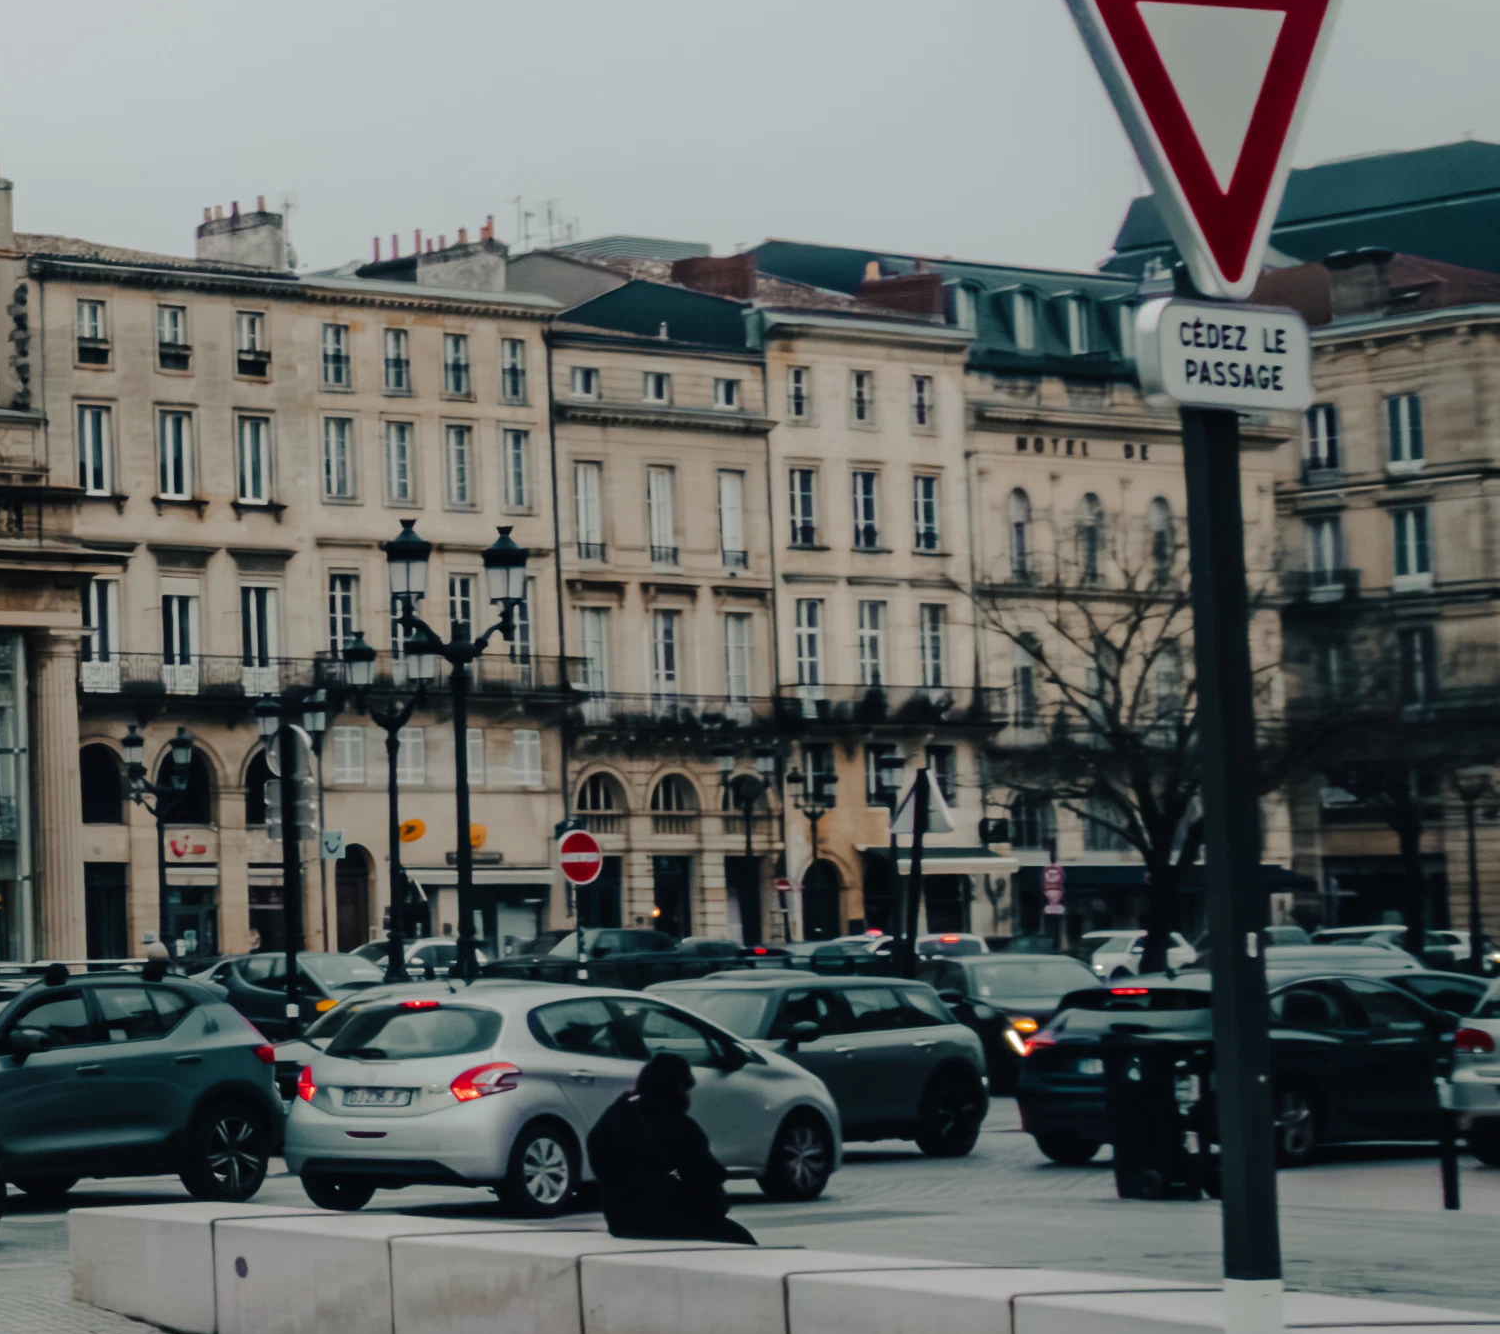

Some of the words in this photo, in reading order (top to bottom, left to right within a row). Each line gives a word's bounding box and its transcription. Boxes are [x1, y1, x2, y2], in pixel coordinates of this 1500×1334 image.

[1179, 317, 1248, 352] CÉDEZ
[1262, 327, 1288, 355] LE
[1185, 358, 1285, 392] PASSAGE
